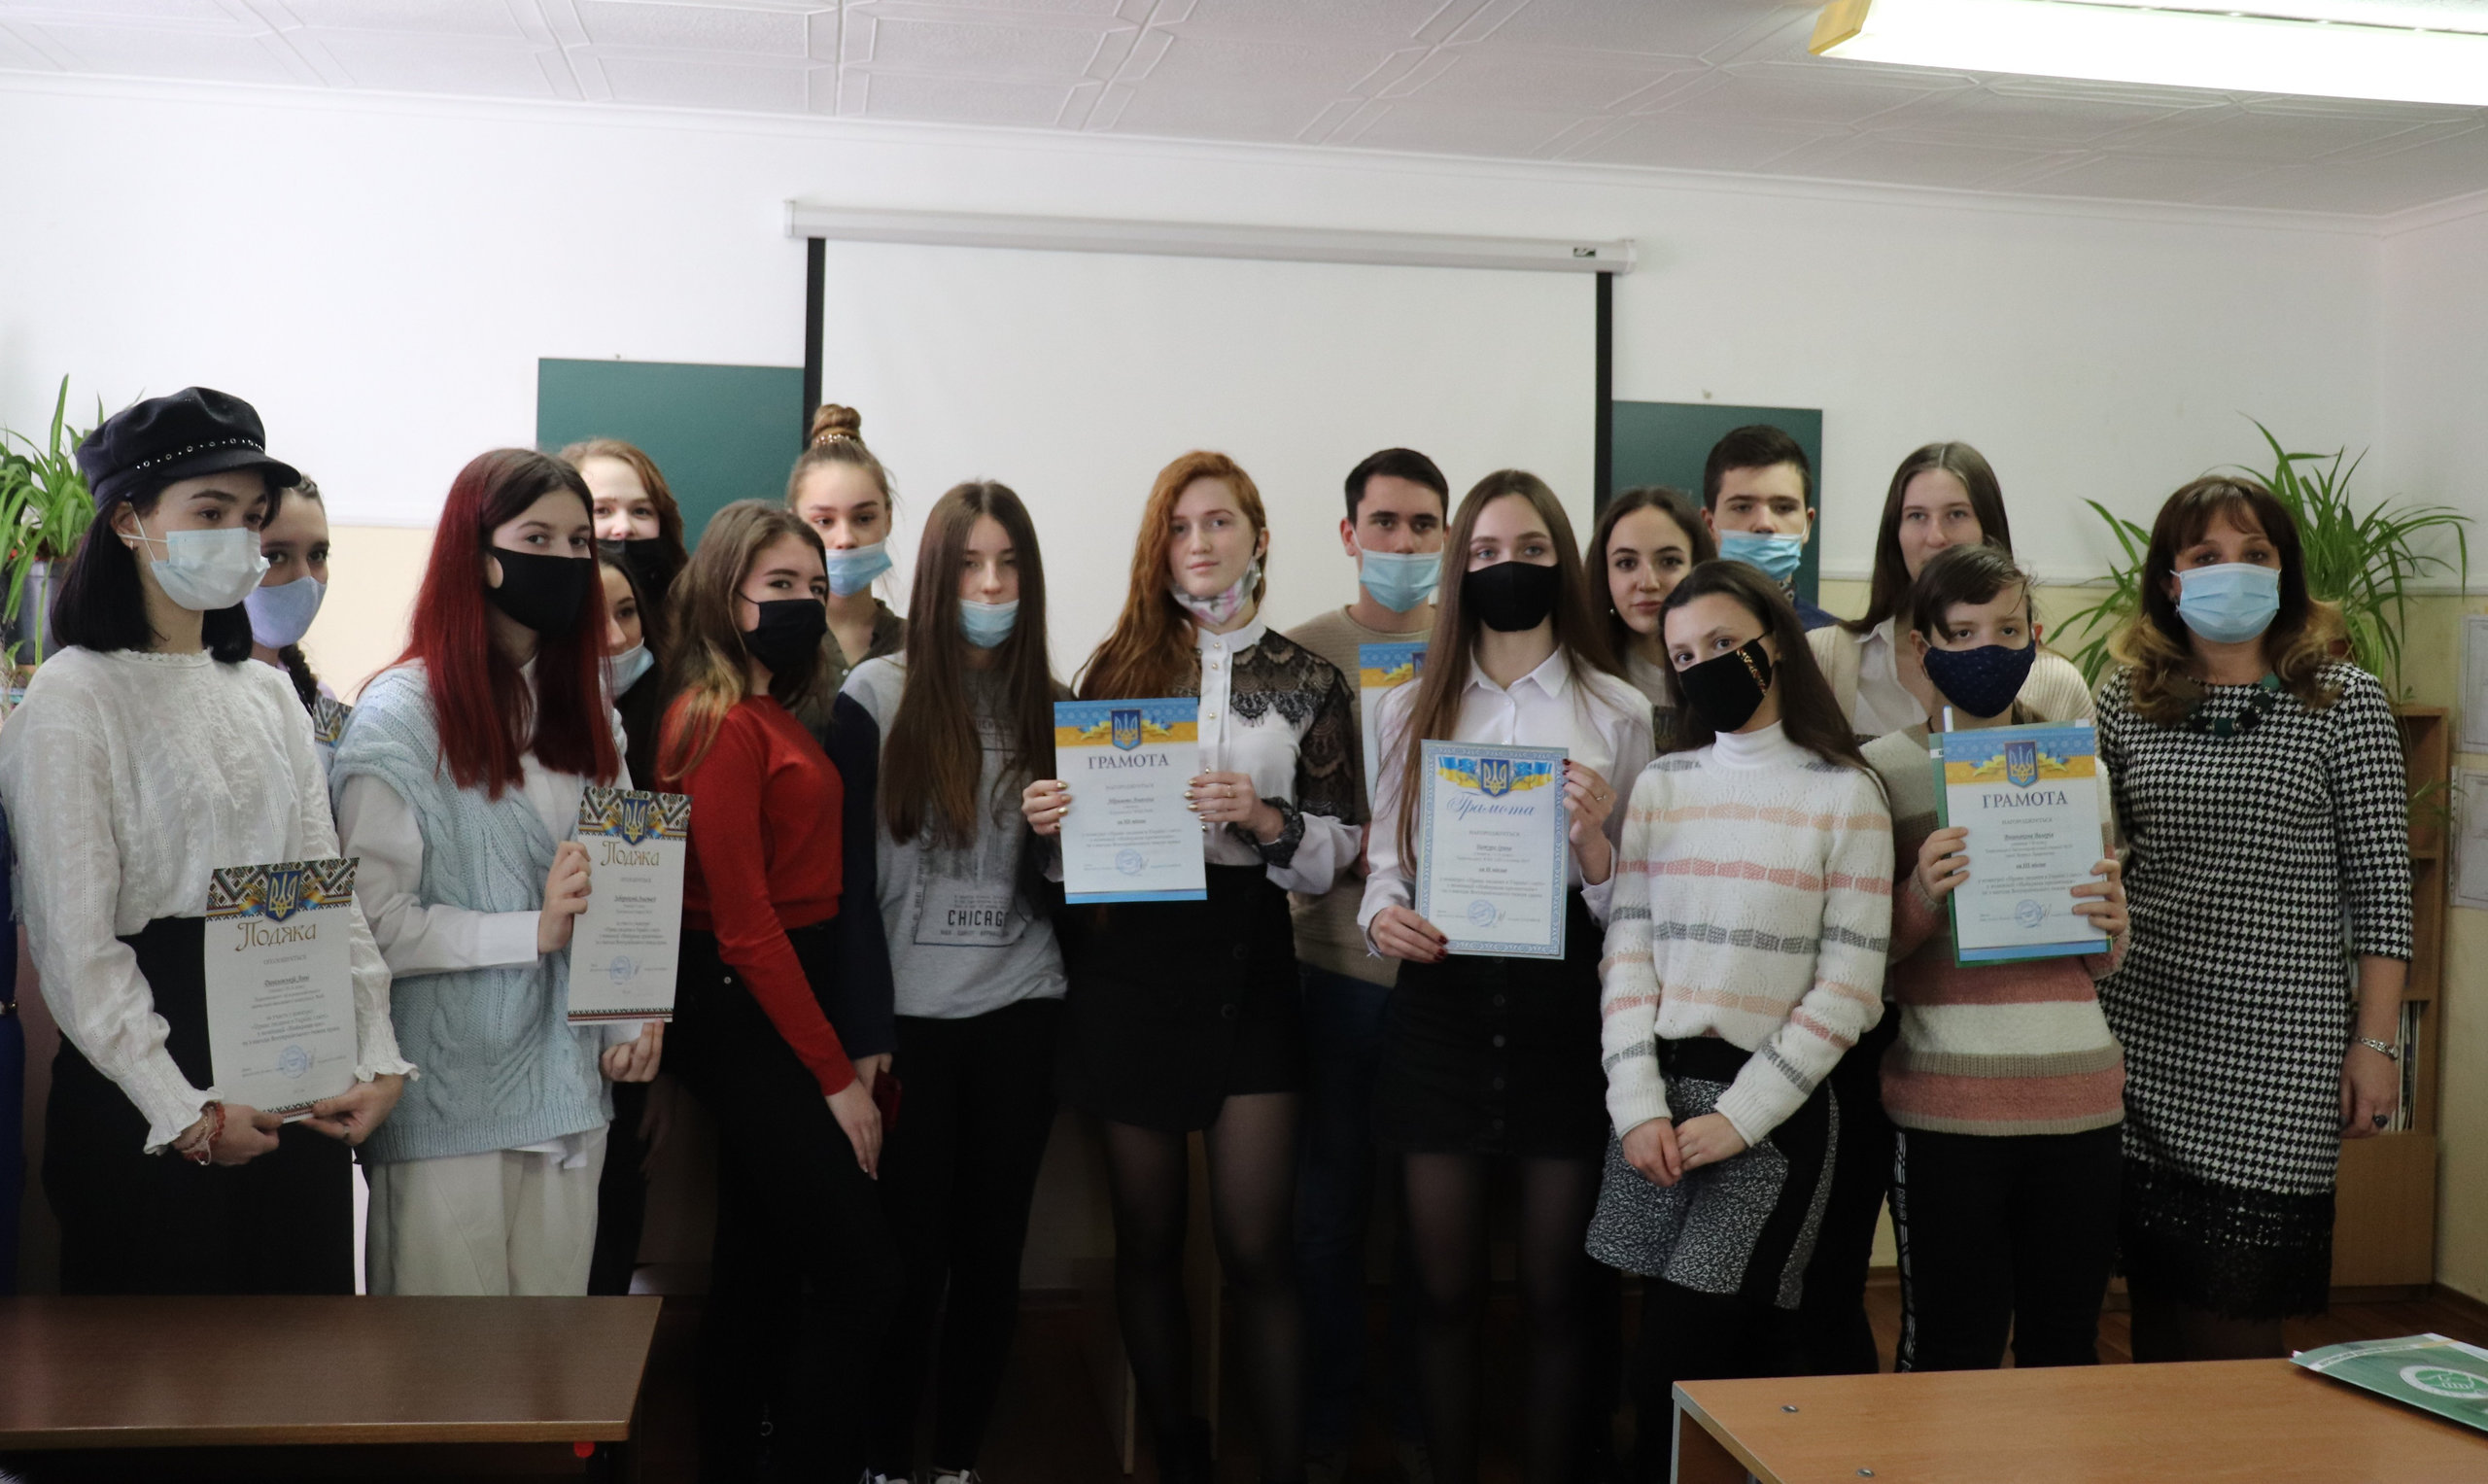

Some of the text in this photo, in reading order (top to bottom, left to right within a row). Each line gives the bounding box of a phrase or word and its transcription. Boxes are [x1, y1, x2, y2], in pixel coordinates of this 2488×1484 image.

[1088, 753, 1170, 770] ГРАМОТА
[1446, 791, 1536, 821] Грамота
[1982, 790, 2068, 810] ГРАМОТА
[600, 840, 660, 867] Подяка
[948, 910, 1009, 927] CHICAG
[235, 919, 317, 951] Подяка
